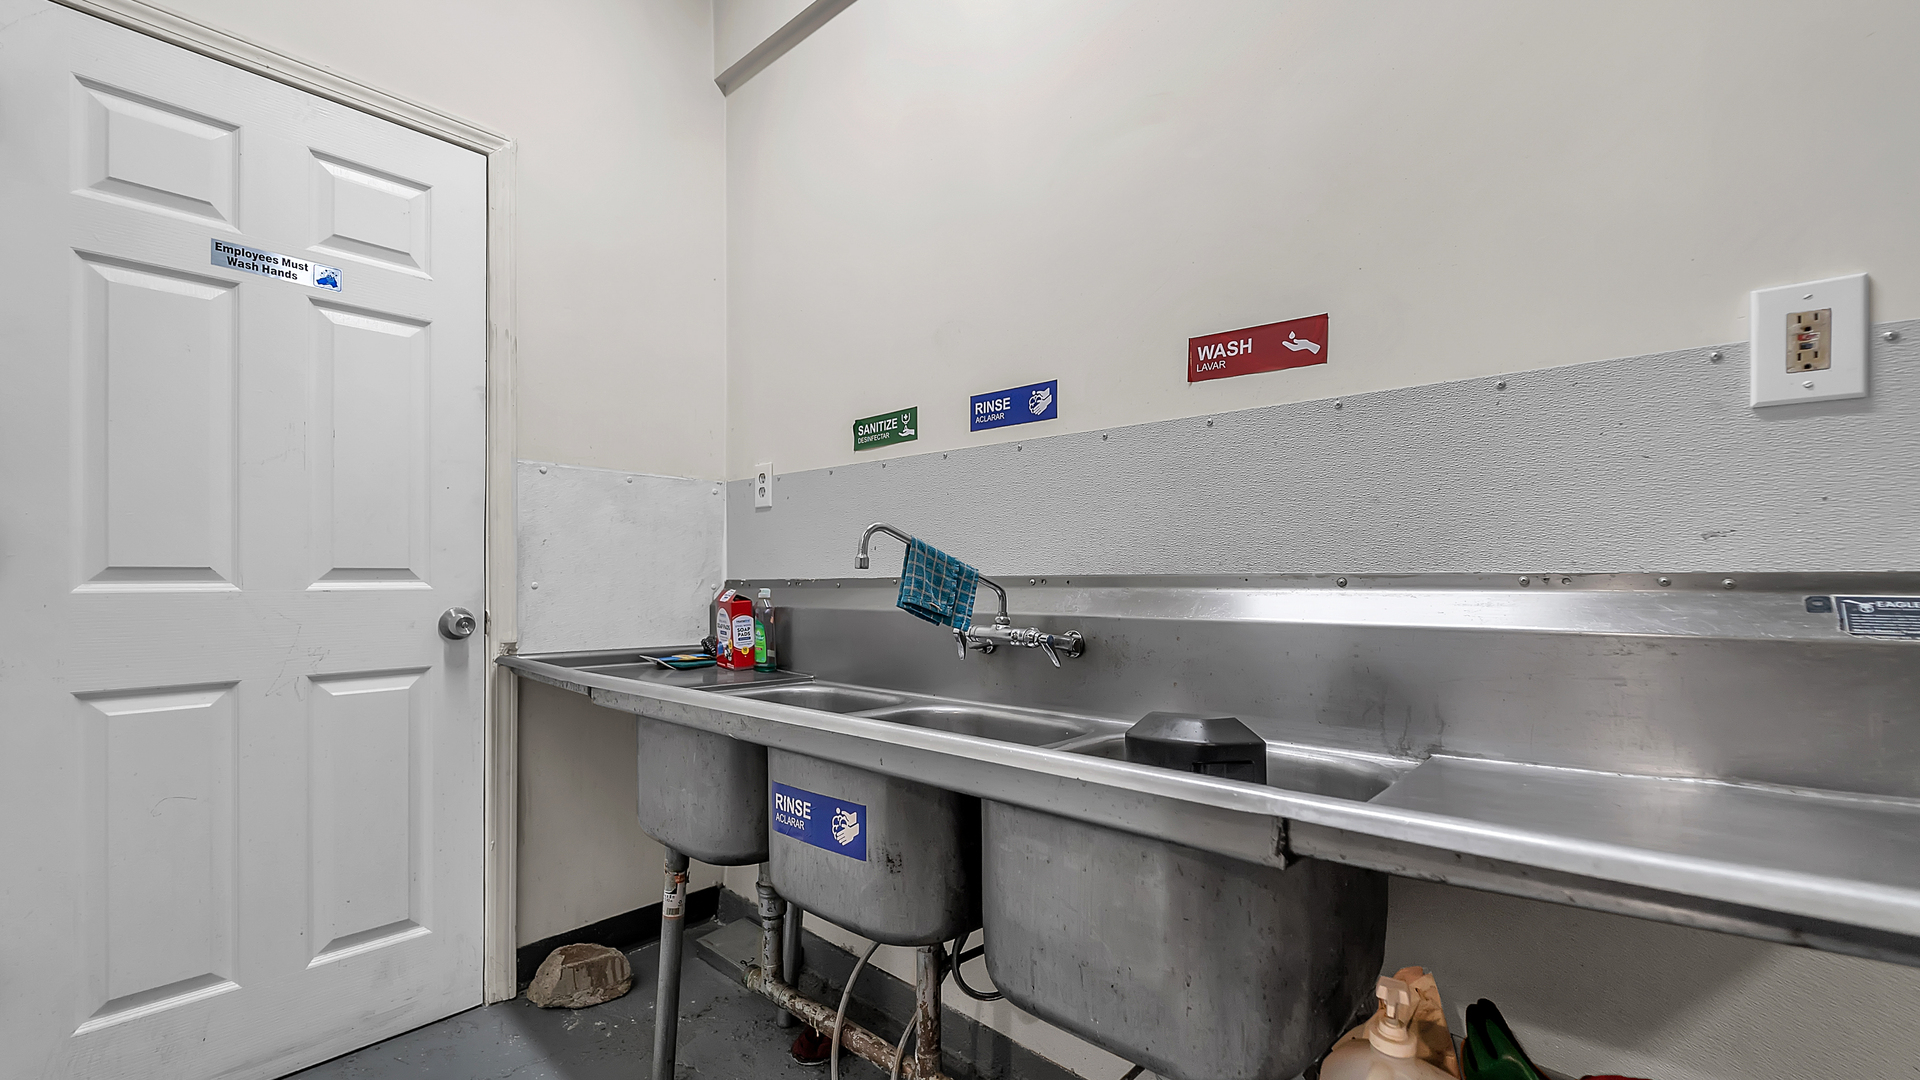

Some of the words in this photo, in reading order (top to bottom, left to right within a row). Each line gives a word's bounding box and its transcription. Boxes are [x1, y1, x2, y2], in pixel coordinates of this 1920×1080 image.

[215, 242, 279, 264] Employees
[281, 258, 309, 272] Must
[227, 256, 259, 271] Wash
[262, 264, 298, 280] Hands
[1197, 338, 1253, 361] WASH
[1196, 360, 1226, 373] LAVAR
[975, 397, 1011, 415] RINSE
[858, 418, 898, 436] SANITIZE
[975, 412, 1005, 424] ACLARAR
[857, 432, 890, 444] DESINFECTAR
[775, 792, 812, 820] RINSE
[775, 812, 805, 831] ACLARAR
